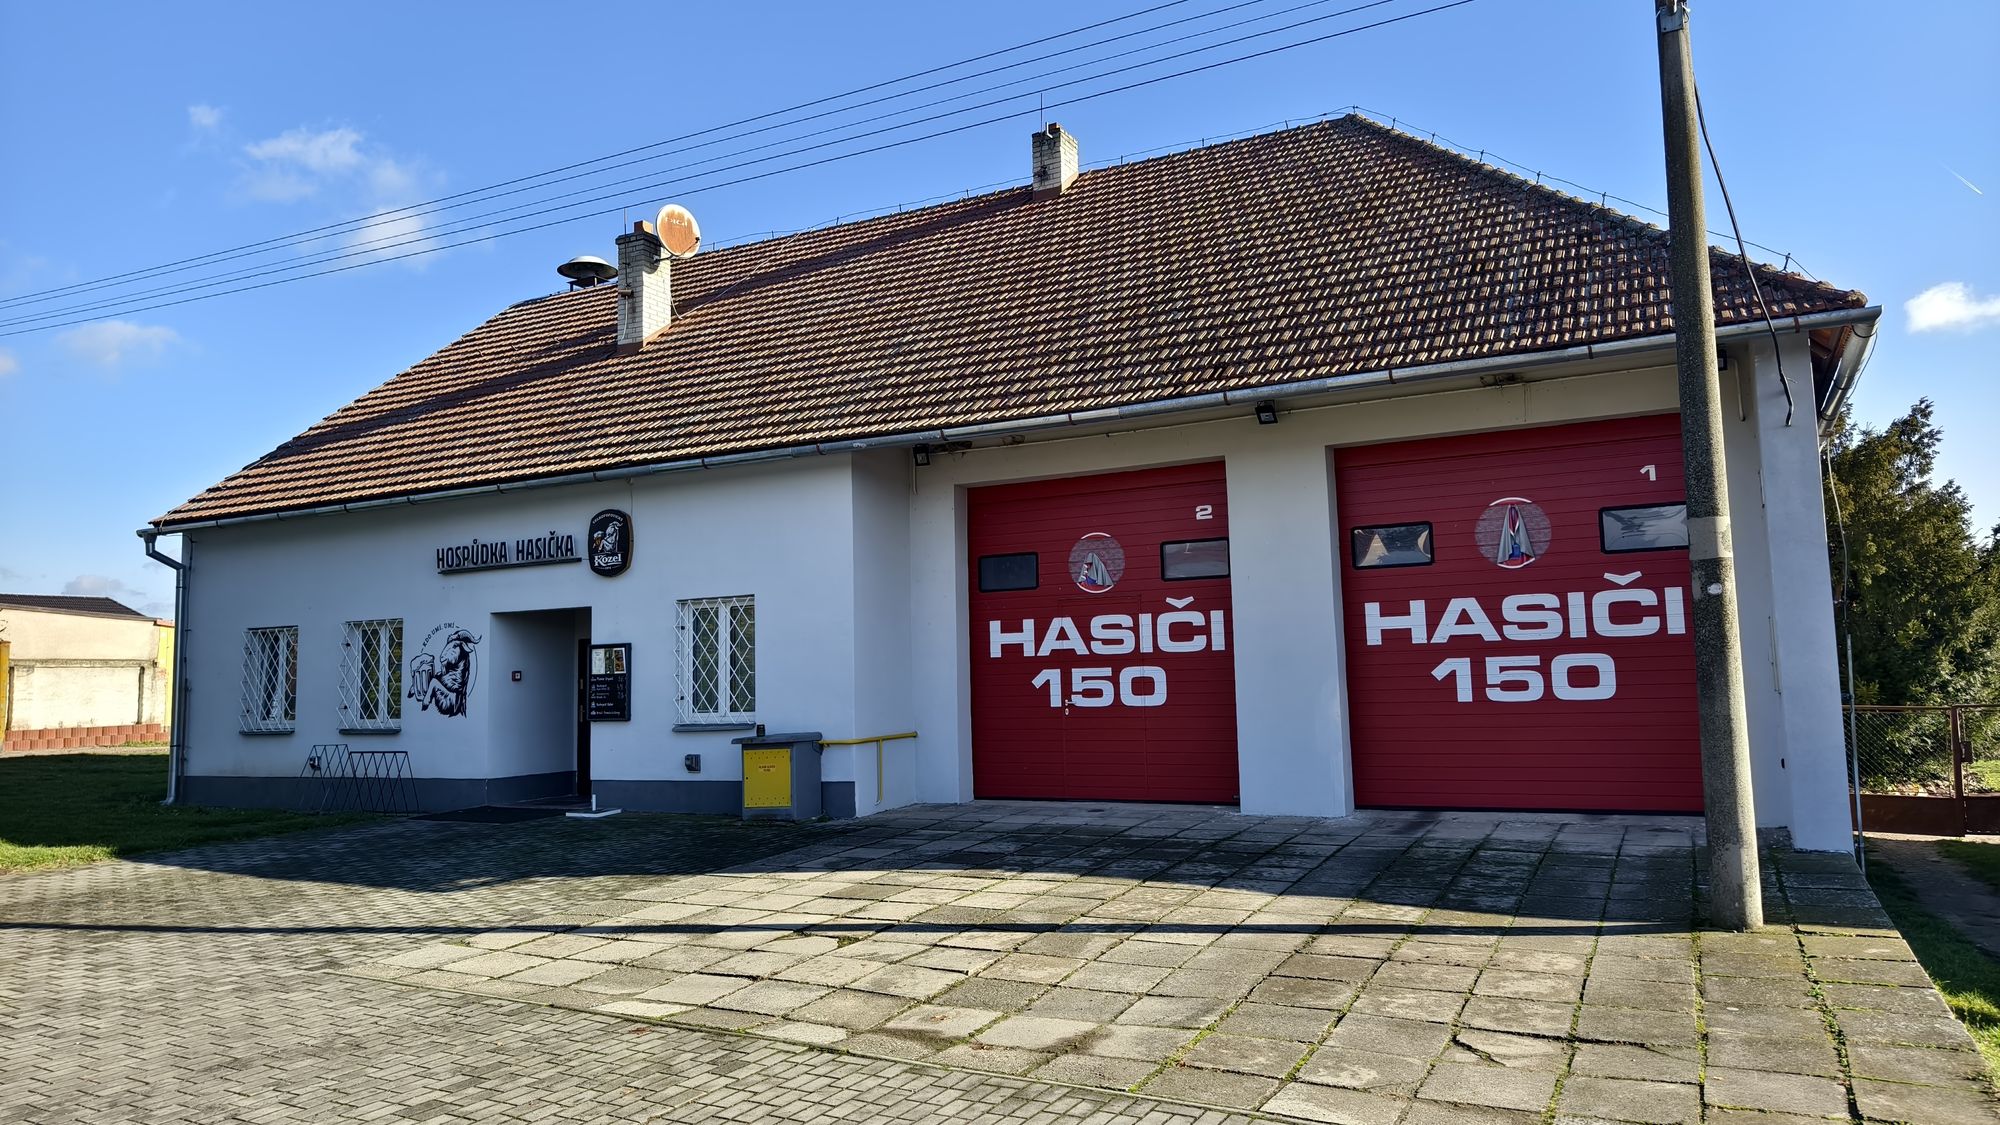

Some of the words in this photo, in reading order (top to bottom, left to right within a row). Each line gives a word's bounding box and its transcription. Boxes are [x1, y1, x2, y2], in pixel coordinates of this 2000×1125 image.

[1639, 464, 1657, 481] 1
[1195, 504, 1213, 521] 2
[437, 539, 508, 569] HOSPŮDKA
[516, 531, 574, 562] HASIČKA
[594, 553, 622, 567] Kozel
[989, 596, 1226, 658] HASIČI
[1364, 571, 1686, 646] HASIČI
[422, 633, 432, 647] KDO
[1031, 665, 1168, 708] 150
[1430, 652, 1617, 703] 150
